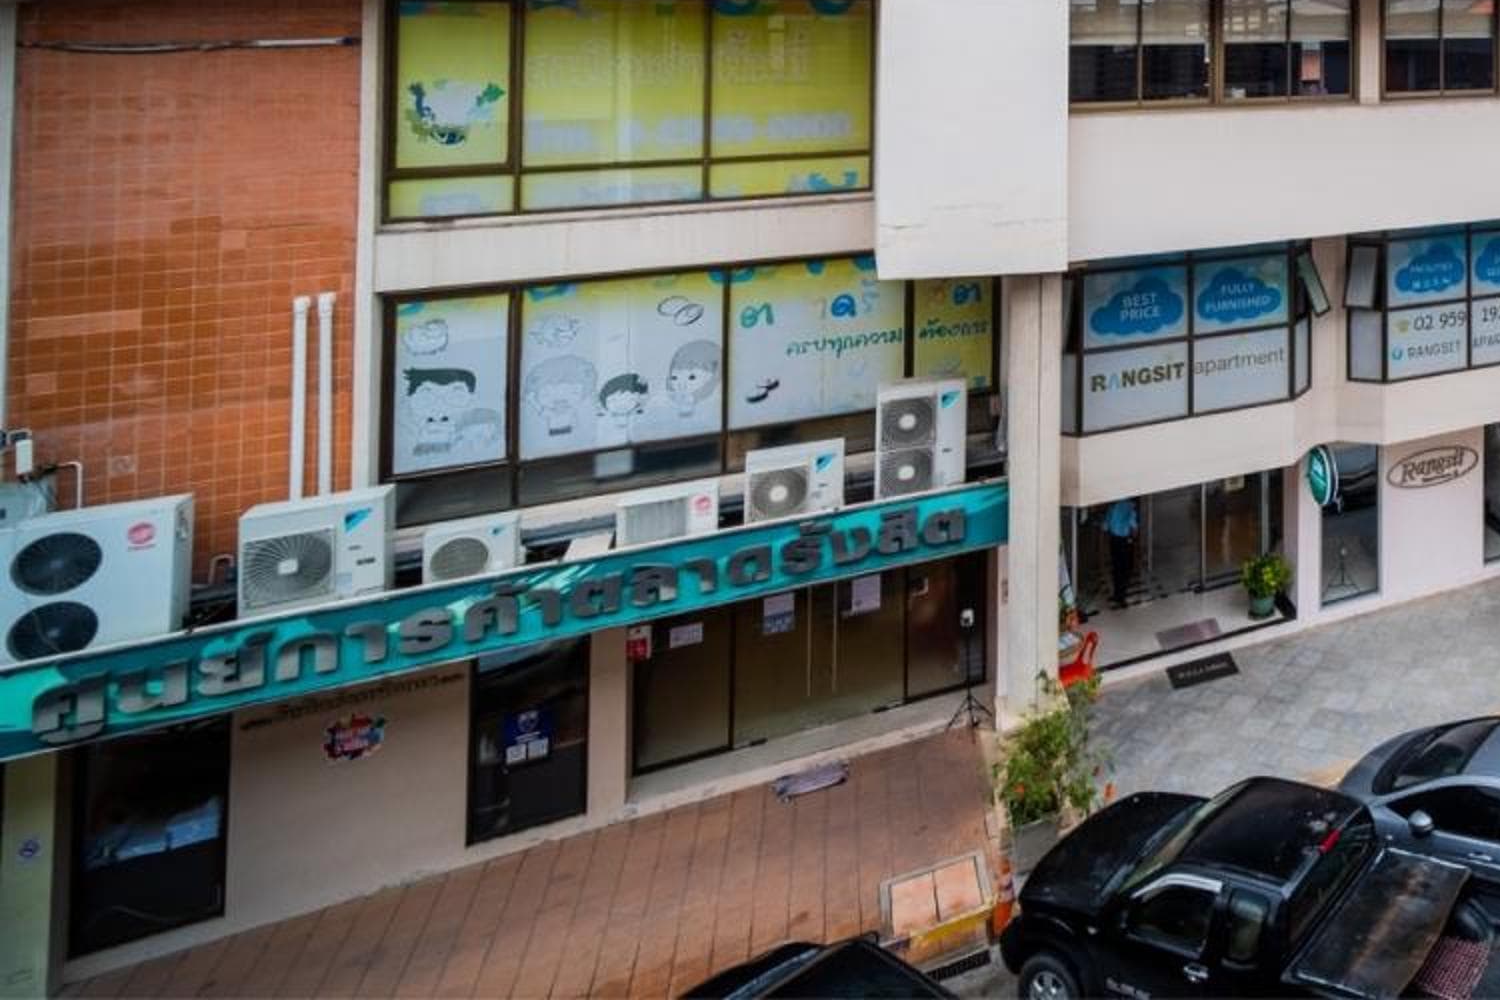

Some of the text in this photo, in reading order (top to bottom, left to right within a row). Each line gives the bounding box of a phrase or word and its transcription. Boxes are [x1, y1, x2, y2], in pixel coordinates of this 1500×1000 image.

[1122, 293, 1157, 308] BEST
[1119, 305, 1161, 323] PRICE
[1413, 316, 1433, 332] 02
[1090, 347, 1285, 394] RANGSIT apartment
